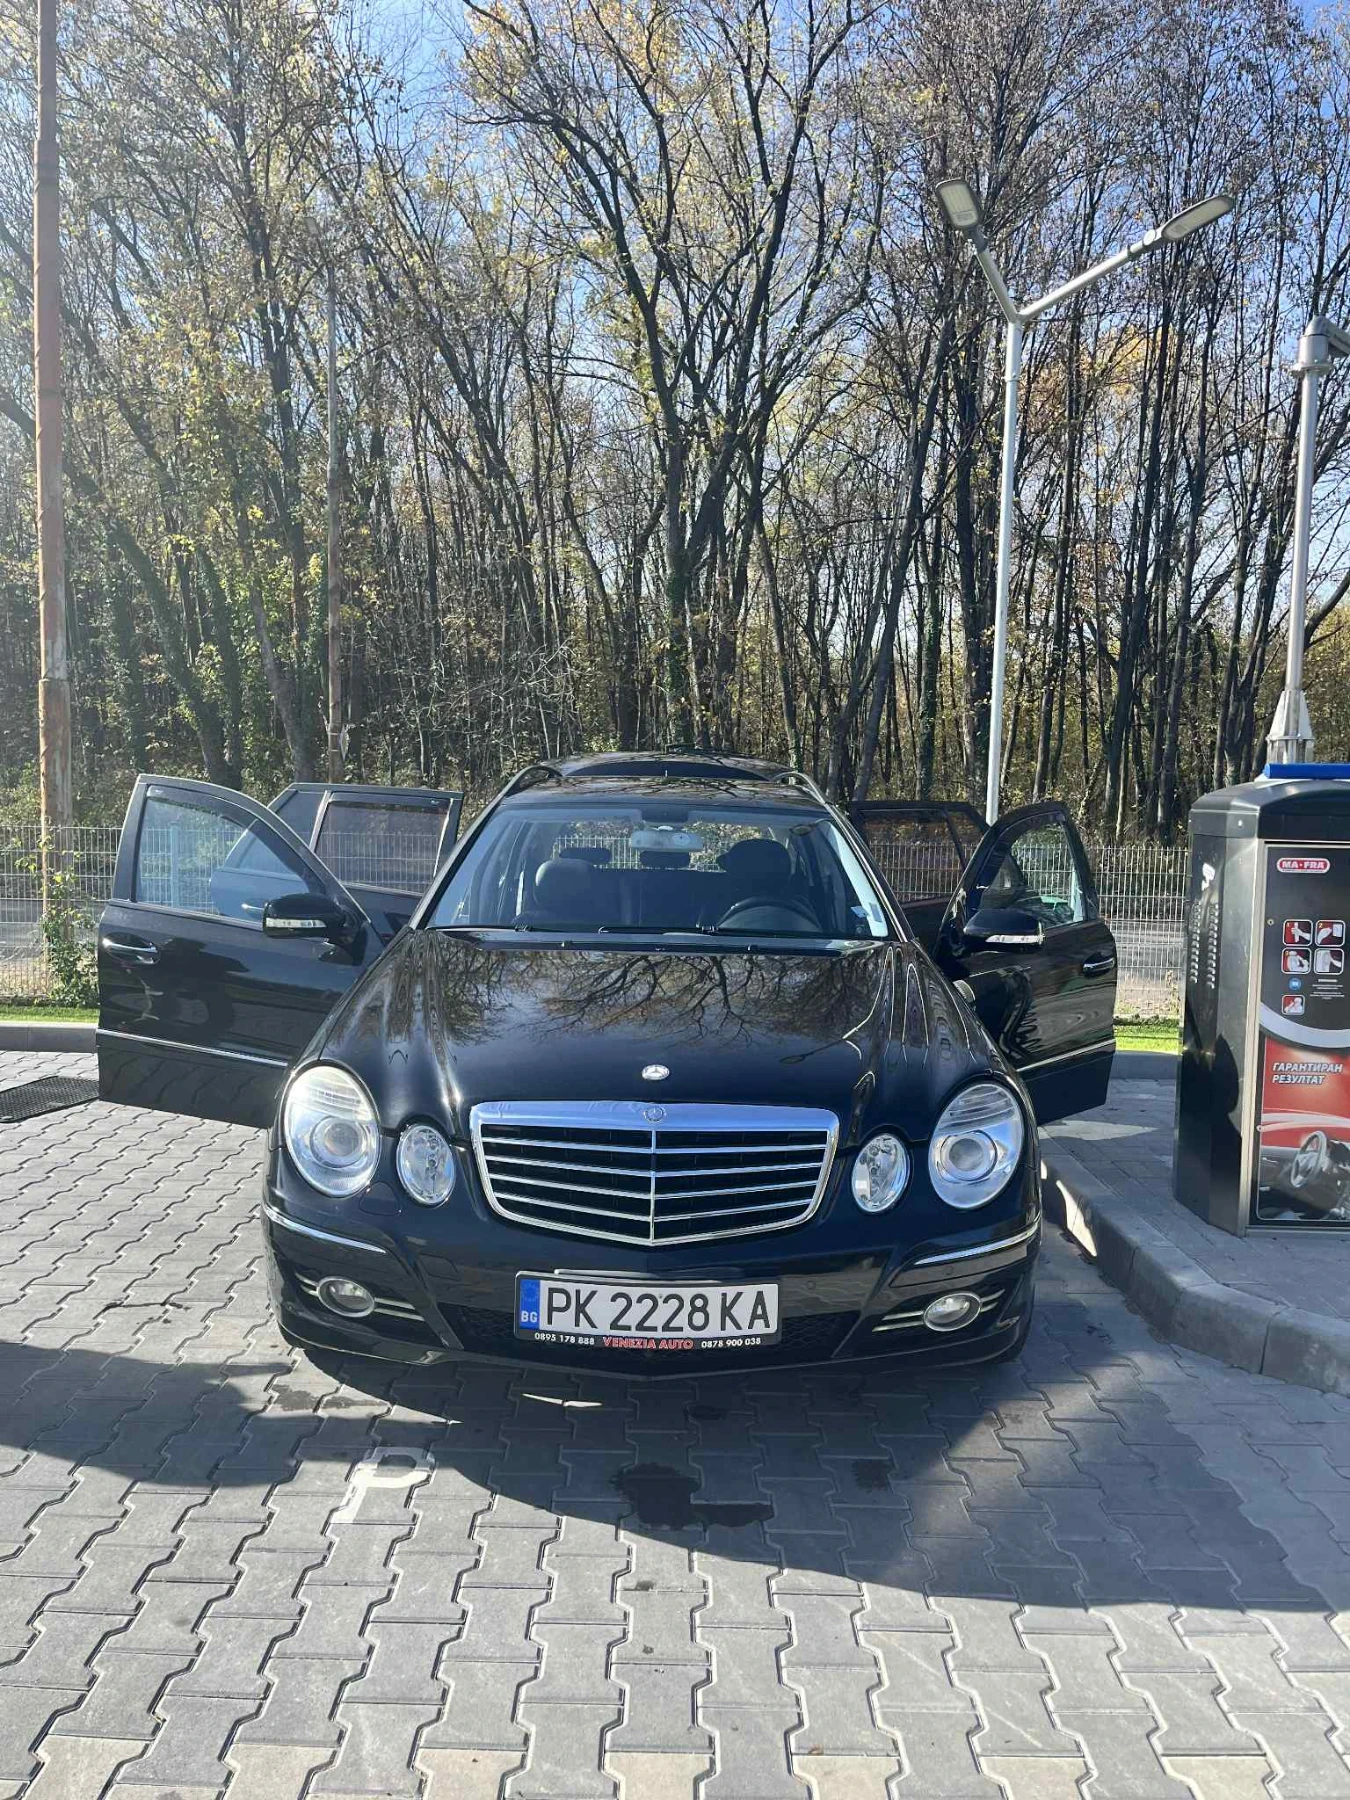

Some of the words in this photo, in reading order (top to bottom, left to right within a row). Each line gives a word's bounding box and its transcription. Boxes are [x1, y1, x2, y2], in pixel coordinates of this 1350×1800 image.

[1272, 1062, 1343, 1073] ГАРАНТИРАН
[1272, 1074, 1325, 1085] РЕЗУЛТАТ
[547, 1287, 598, 1329] PK
[609, 1292, 710, 1332] 2228
[720, 1290, 771, 1331] KA
[521, 1310, 538, 1323] BG
[602, 1336, 656, 1349] VENEZIA
[659, 1338, 695, 1350] AUTO
[726, 1338, 743, 1347] 900
[745, 1337, 761, 1346] 038
